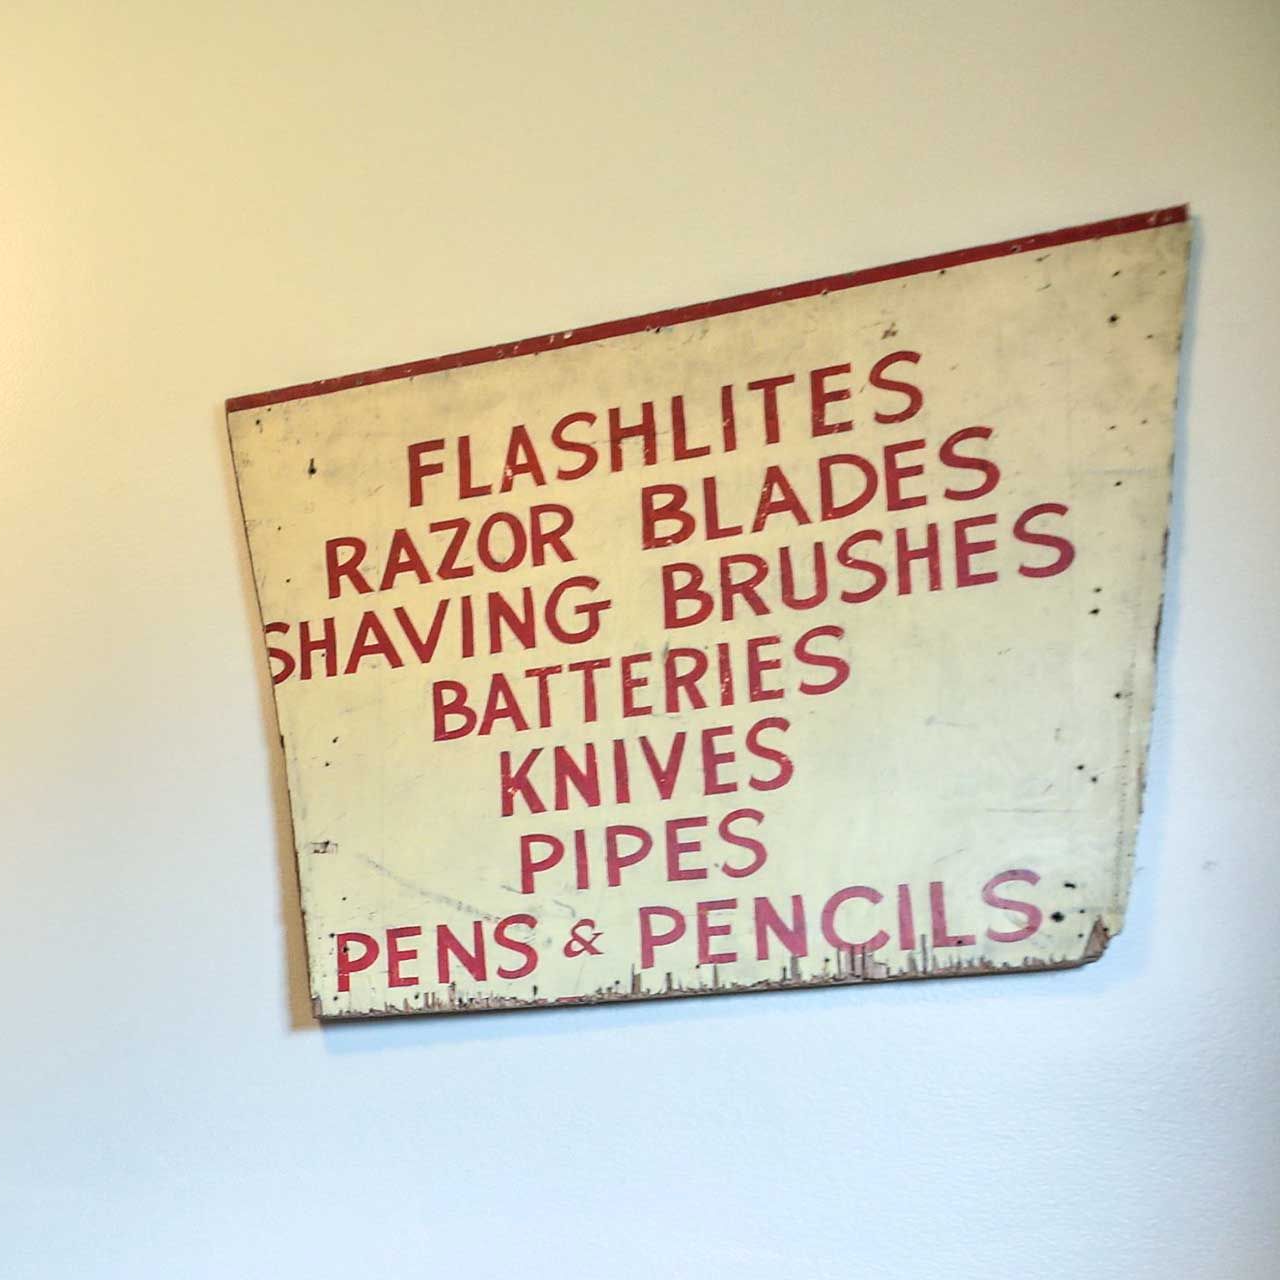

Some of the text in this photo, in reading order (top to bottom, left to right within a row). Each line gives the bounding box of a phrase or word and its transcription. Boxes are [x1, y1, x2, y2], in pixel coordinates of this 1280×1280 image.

[406, 350, 926, 509] FLASHLITES
[325, 424, 1003, 600] RAZOR BLADES
[263, 501, 1077, 686] SHAVING BRUSHES
[431, 624, 853, 743] BATTERIES
[498, 715, 796, 818] KNIVES
[518, 807, 768, 895] PIPES
[336, 868, 1044, 994] PENS & PENCILS
